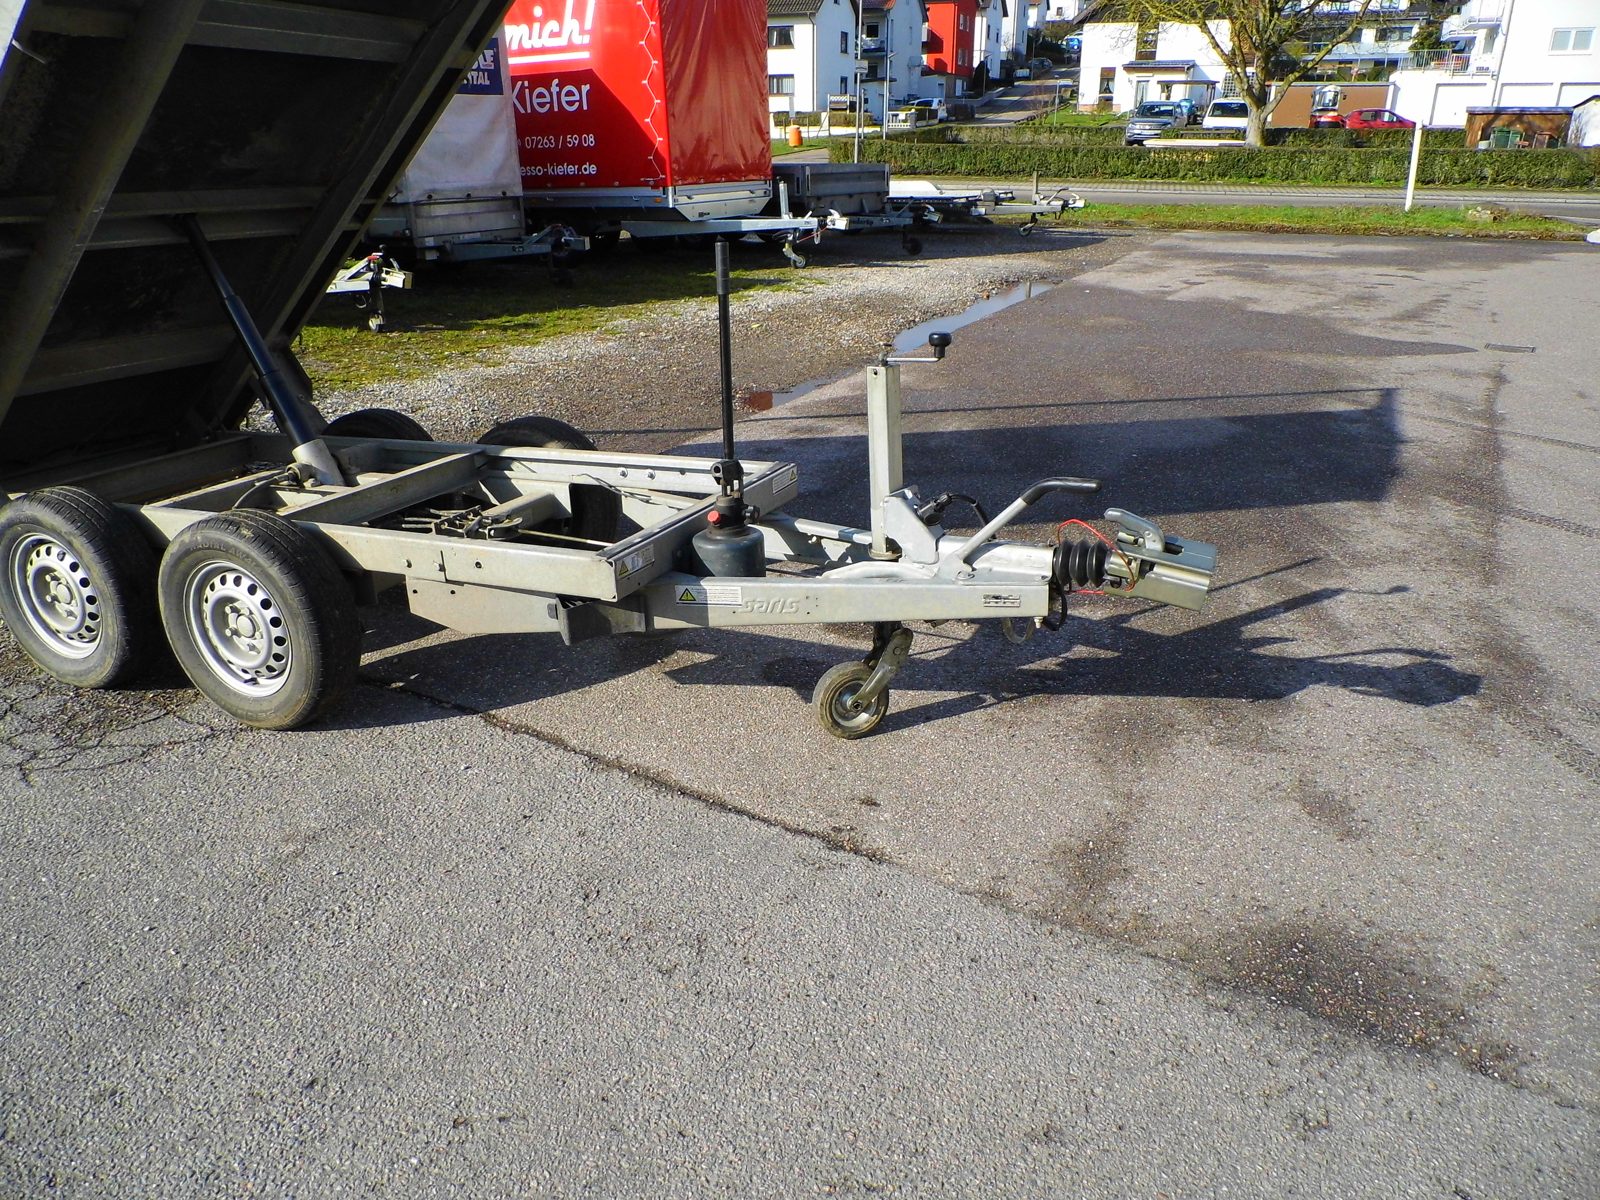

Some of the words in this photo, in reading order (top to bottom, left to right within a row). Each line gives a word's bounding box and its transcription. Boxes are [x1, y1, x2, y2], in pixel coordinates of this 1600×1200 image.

[512, 79, 590, 113] Kiefer
[525, 136, 555, 149] 07263
[558, 136, 563, 149] /
[566, 134, 579, 147] 59
[581, 133, 595, 147] 08
[520, 162, 597, 176] esso-kiefer.de
